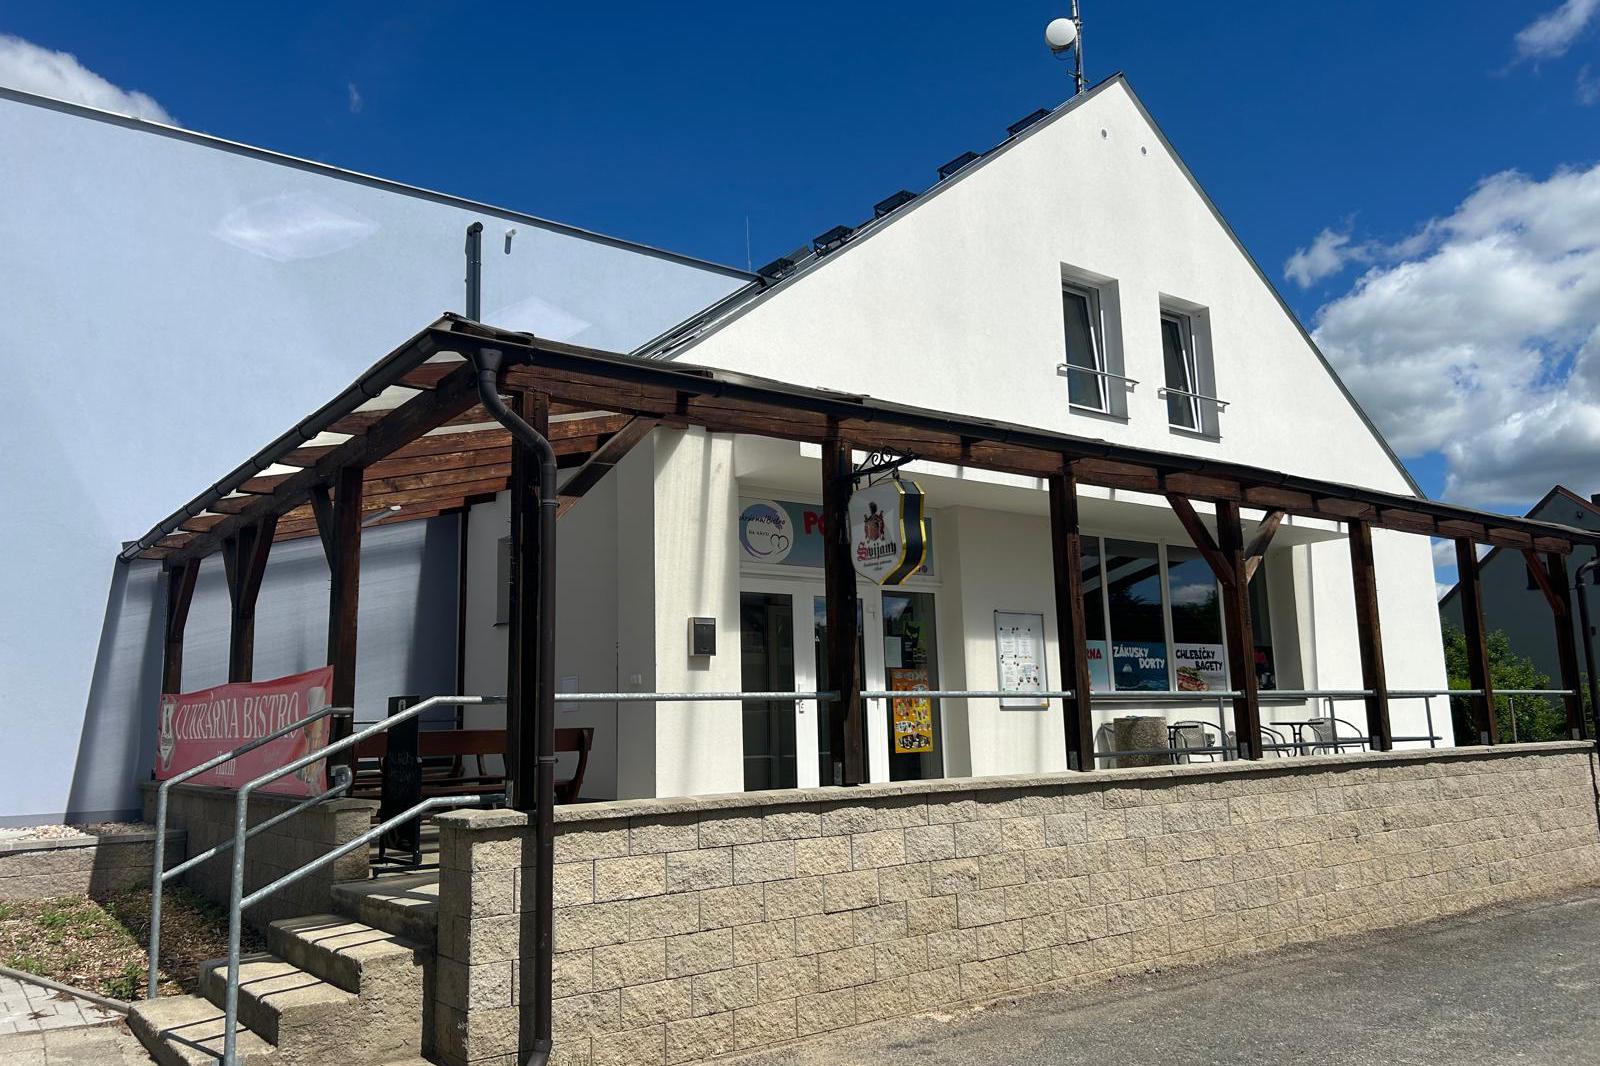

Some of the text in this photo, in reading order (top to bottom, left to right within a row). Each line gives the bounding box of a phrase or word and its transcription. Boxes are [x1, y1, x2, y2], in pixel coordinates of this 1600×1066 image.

[857, 541, 897, 561] Svijany
[1113, 644, 1149, 658] ZÁKUSKY
[1175, 647, 1215, 659] CHLEBÍČKY
[1139, 658, 1165, 669] DORTY
[1195, 661, 1222, 671] BAGETY
[175, 691, 299, 740] CUKRÁRNA BISTRO
